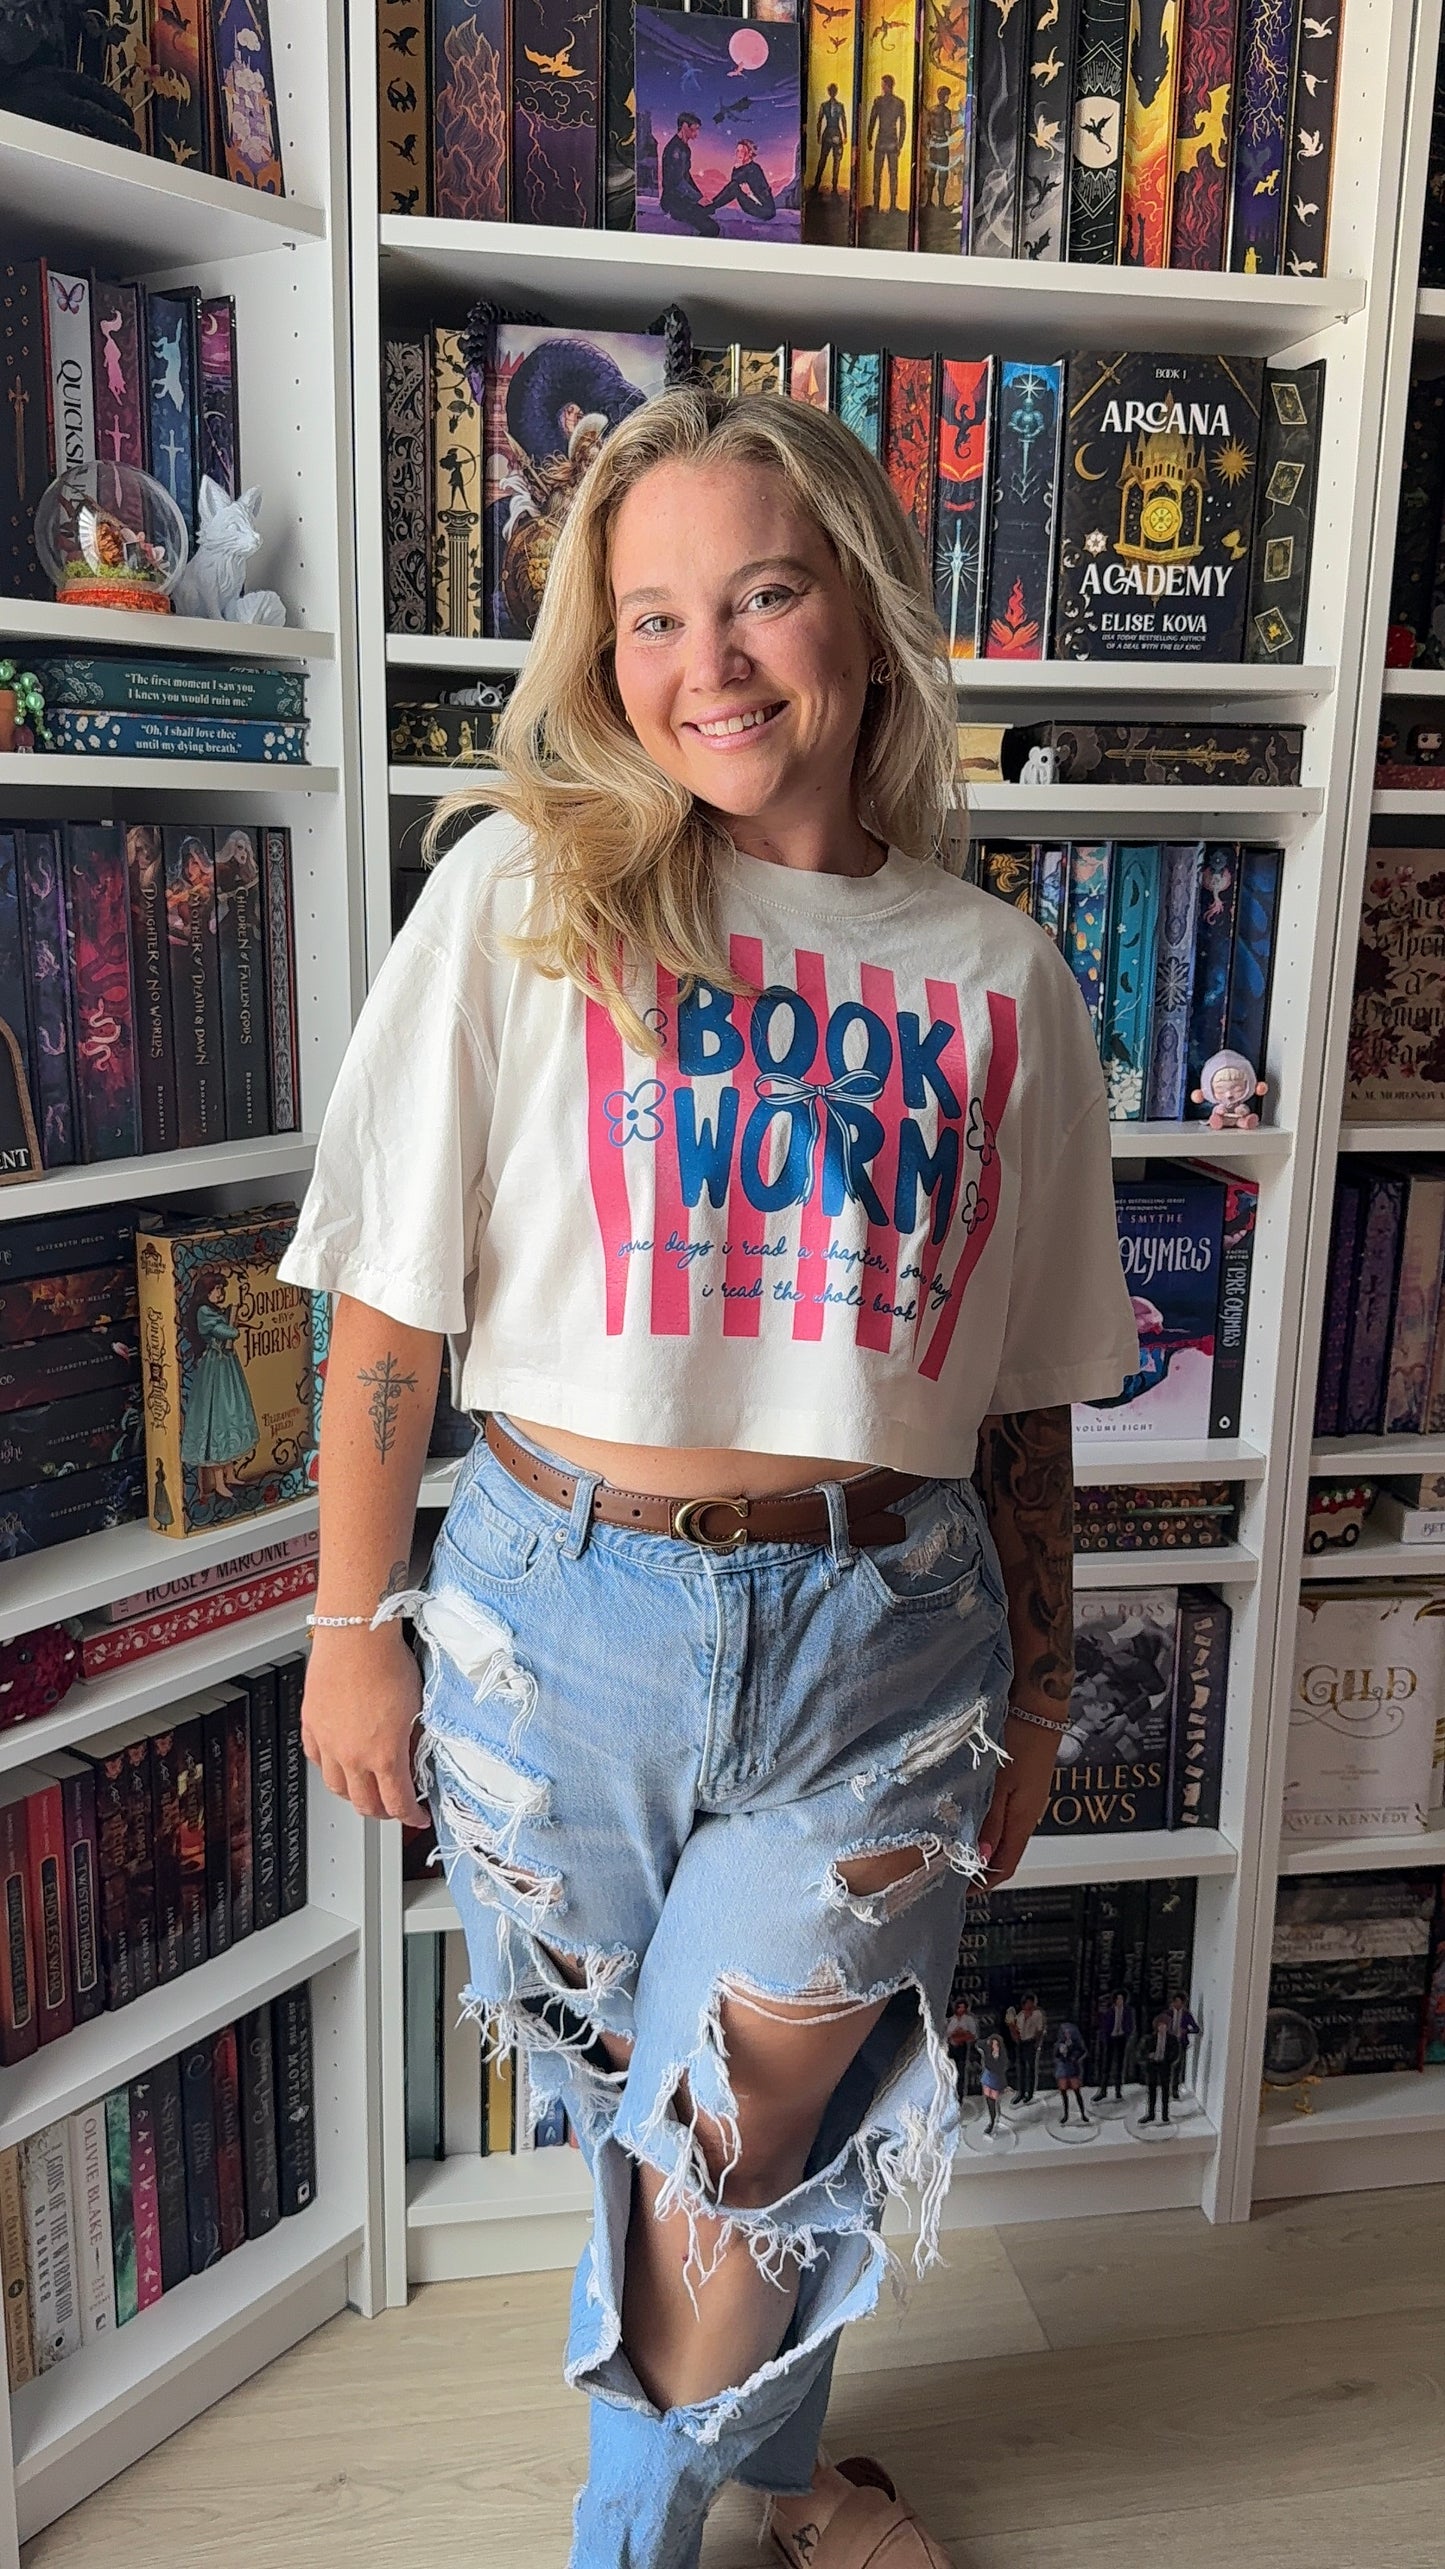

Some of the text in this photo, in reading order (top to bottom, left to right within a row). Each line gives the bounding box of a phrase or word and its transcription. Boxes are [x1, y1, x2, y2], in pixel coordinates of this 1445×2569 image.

[1155, 369, 1180, 379] BOOK
[1100, 400, 1231, 436] ARCANA
[1079, 562, 1234, 597] ACADEMY
[1101, 613, 1208, 633] ELISE KOVA
[1138, 634, 1178, 642] BESTSELLING
[134, 690, 159, 702] knew
[161, 692, 179, 704] you
[182, 693, 209, 705] would
[212, 695, 230, 706] ruin
[151, 674, 171, 686] first
[174, 678, 210, 690] moment
[219, 682, 235, 692] saw
[136, 739, 159, 751] until
[161, 741, 177, 753] my
[178, 741, 204, 755] dying
[170, 725, 194, 738] shall
[196, 726, 215, 738] love
[217, 728, 236, 740] thee
[235, 886, 252, 949] CHILDREN
[146, 978, 161, 1002] NO
[192, 968, 206, 1014] DEATH
[238, 963, 251, 1009] FALLEN
[240, 1010, 252, 1045] GODS
[677, 974, 961, 1119] BOOK
[195, 1028, 209, 1067] DAWN
[673, 1086, 959, 1245] WORM
[1131, 1214, 1183, 1224] SMYTHE
[665, 1230, 714, 1269] days
[723, 1242, 731, 1255] i
[742, 1235, 787, 1257] read
[797, 1248, 812, 1259] a
[1119, 1236, 1211, 1286] OLYMPUS
[239, 1282, 302, 1324] BONDED
[722, 1278, 763, 1299] read
[773, 1280, 804, 1301] the
[872, 1293, 917, 1322] book
[239, 1320, 301, 1367] THORNS
[1118, 1602, 1167, 1618] ROSS
[1299, 1664, 1417, 1712] GILD
[1052, 1763, 1161, 1791] THLESS
[1337, 1811, 1411, 1827] KENNEDY
[44, 1882, 61, 1994] ENDLESS WAR
[76, 1864, 93, 1981] TWISTED THRONE
[288, 2053, 300, 2107] MOTH
[83, 2119, 103, 2245] OLIVIE BLAKE
[47, 2155, 74, 2324] GODS OF THE WYRDWOOD
[36, 2238, 51, 2303] BARKER
